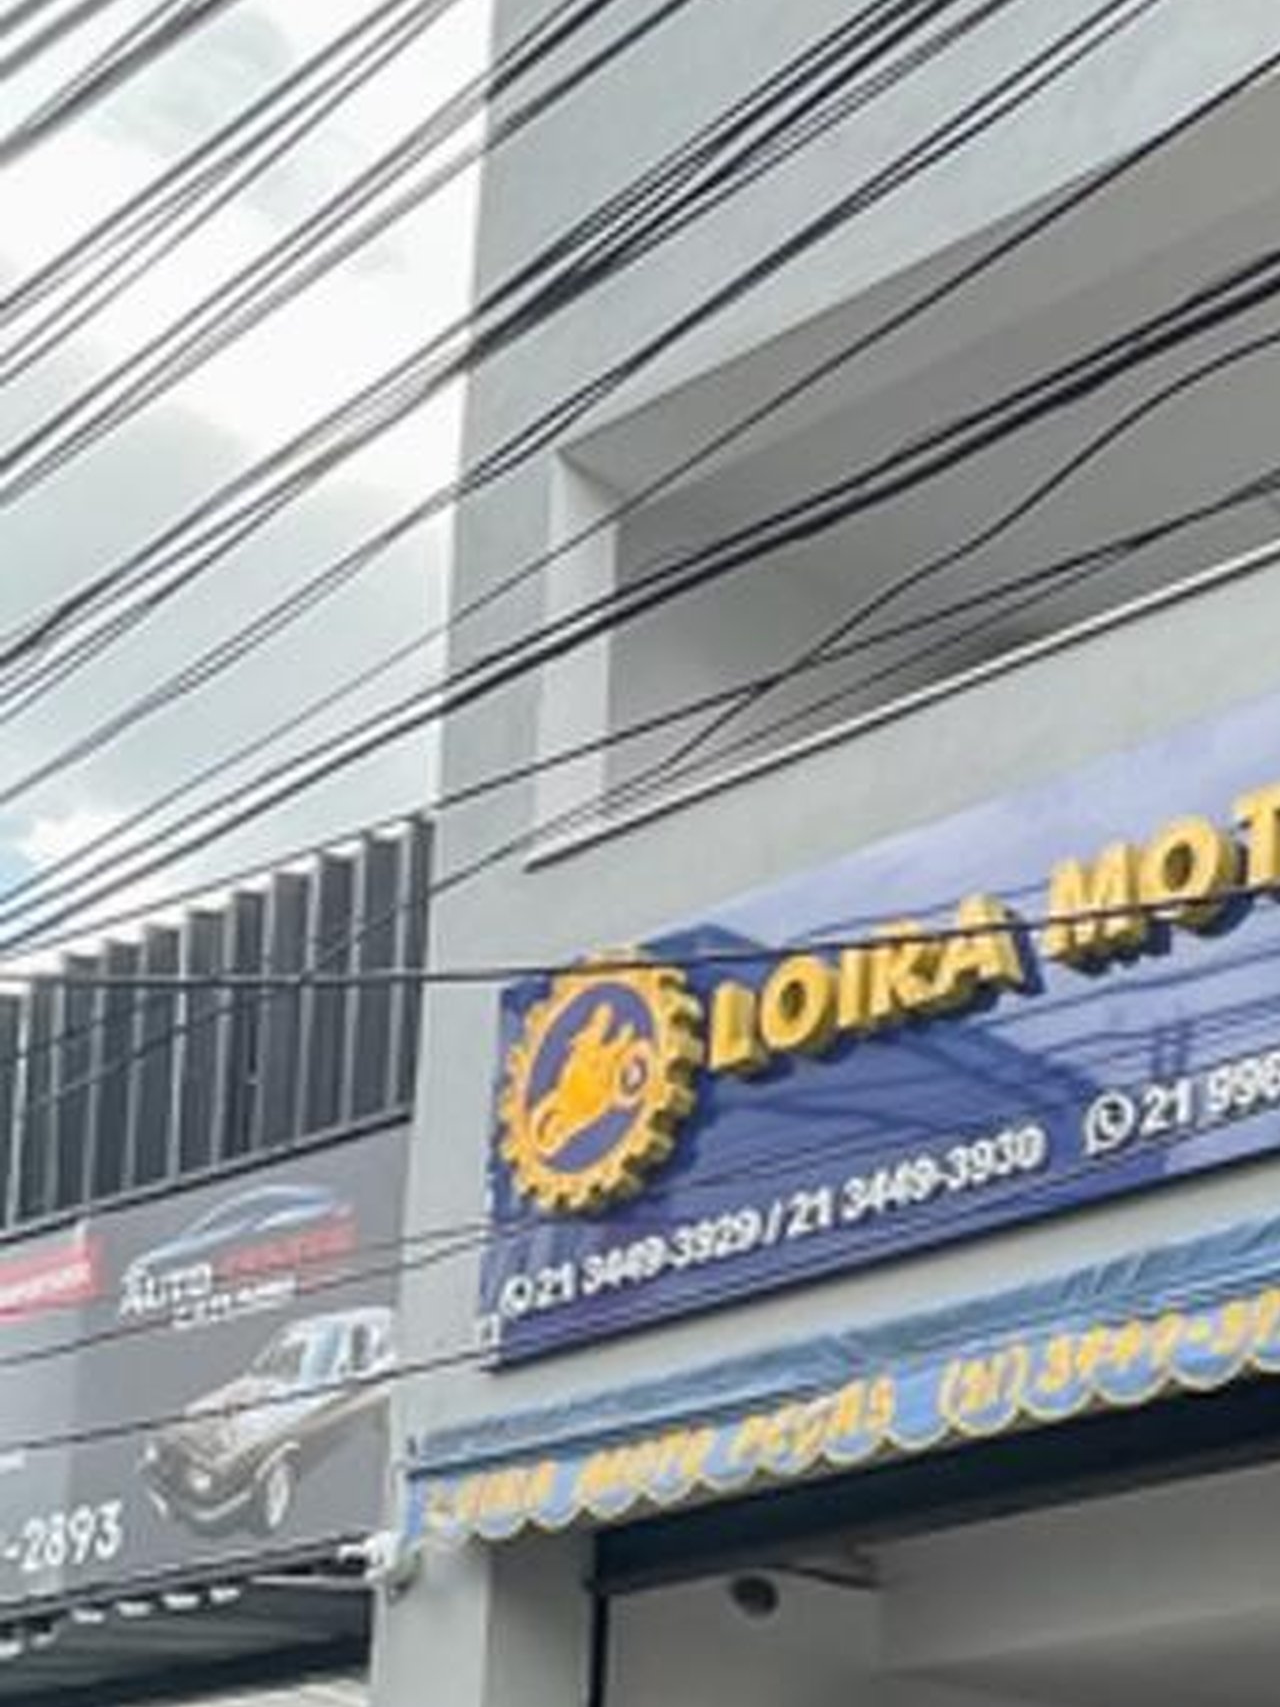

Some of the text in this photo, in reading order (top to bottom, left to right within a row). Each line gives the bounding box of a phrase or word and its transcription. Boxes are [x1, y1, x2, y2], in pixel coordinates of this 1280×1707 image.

[708, 892, 1026, 1074] LOIRA
[1140, 1080, 1192, 1136] 21
[533, 1263, 576, 1304] 21
[785, 1187, 834, 1238] 21
[842, 1124, 1048, 1222] 3449-3930
